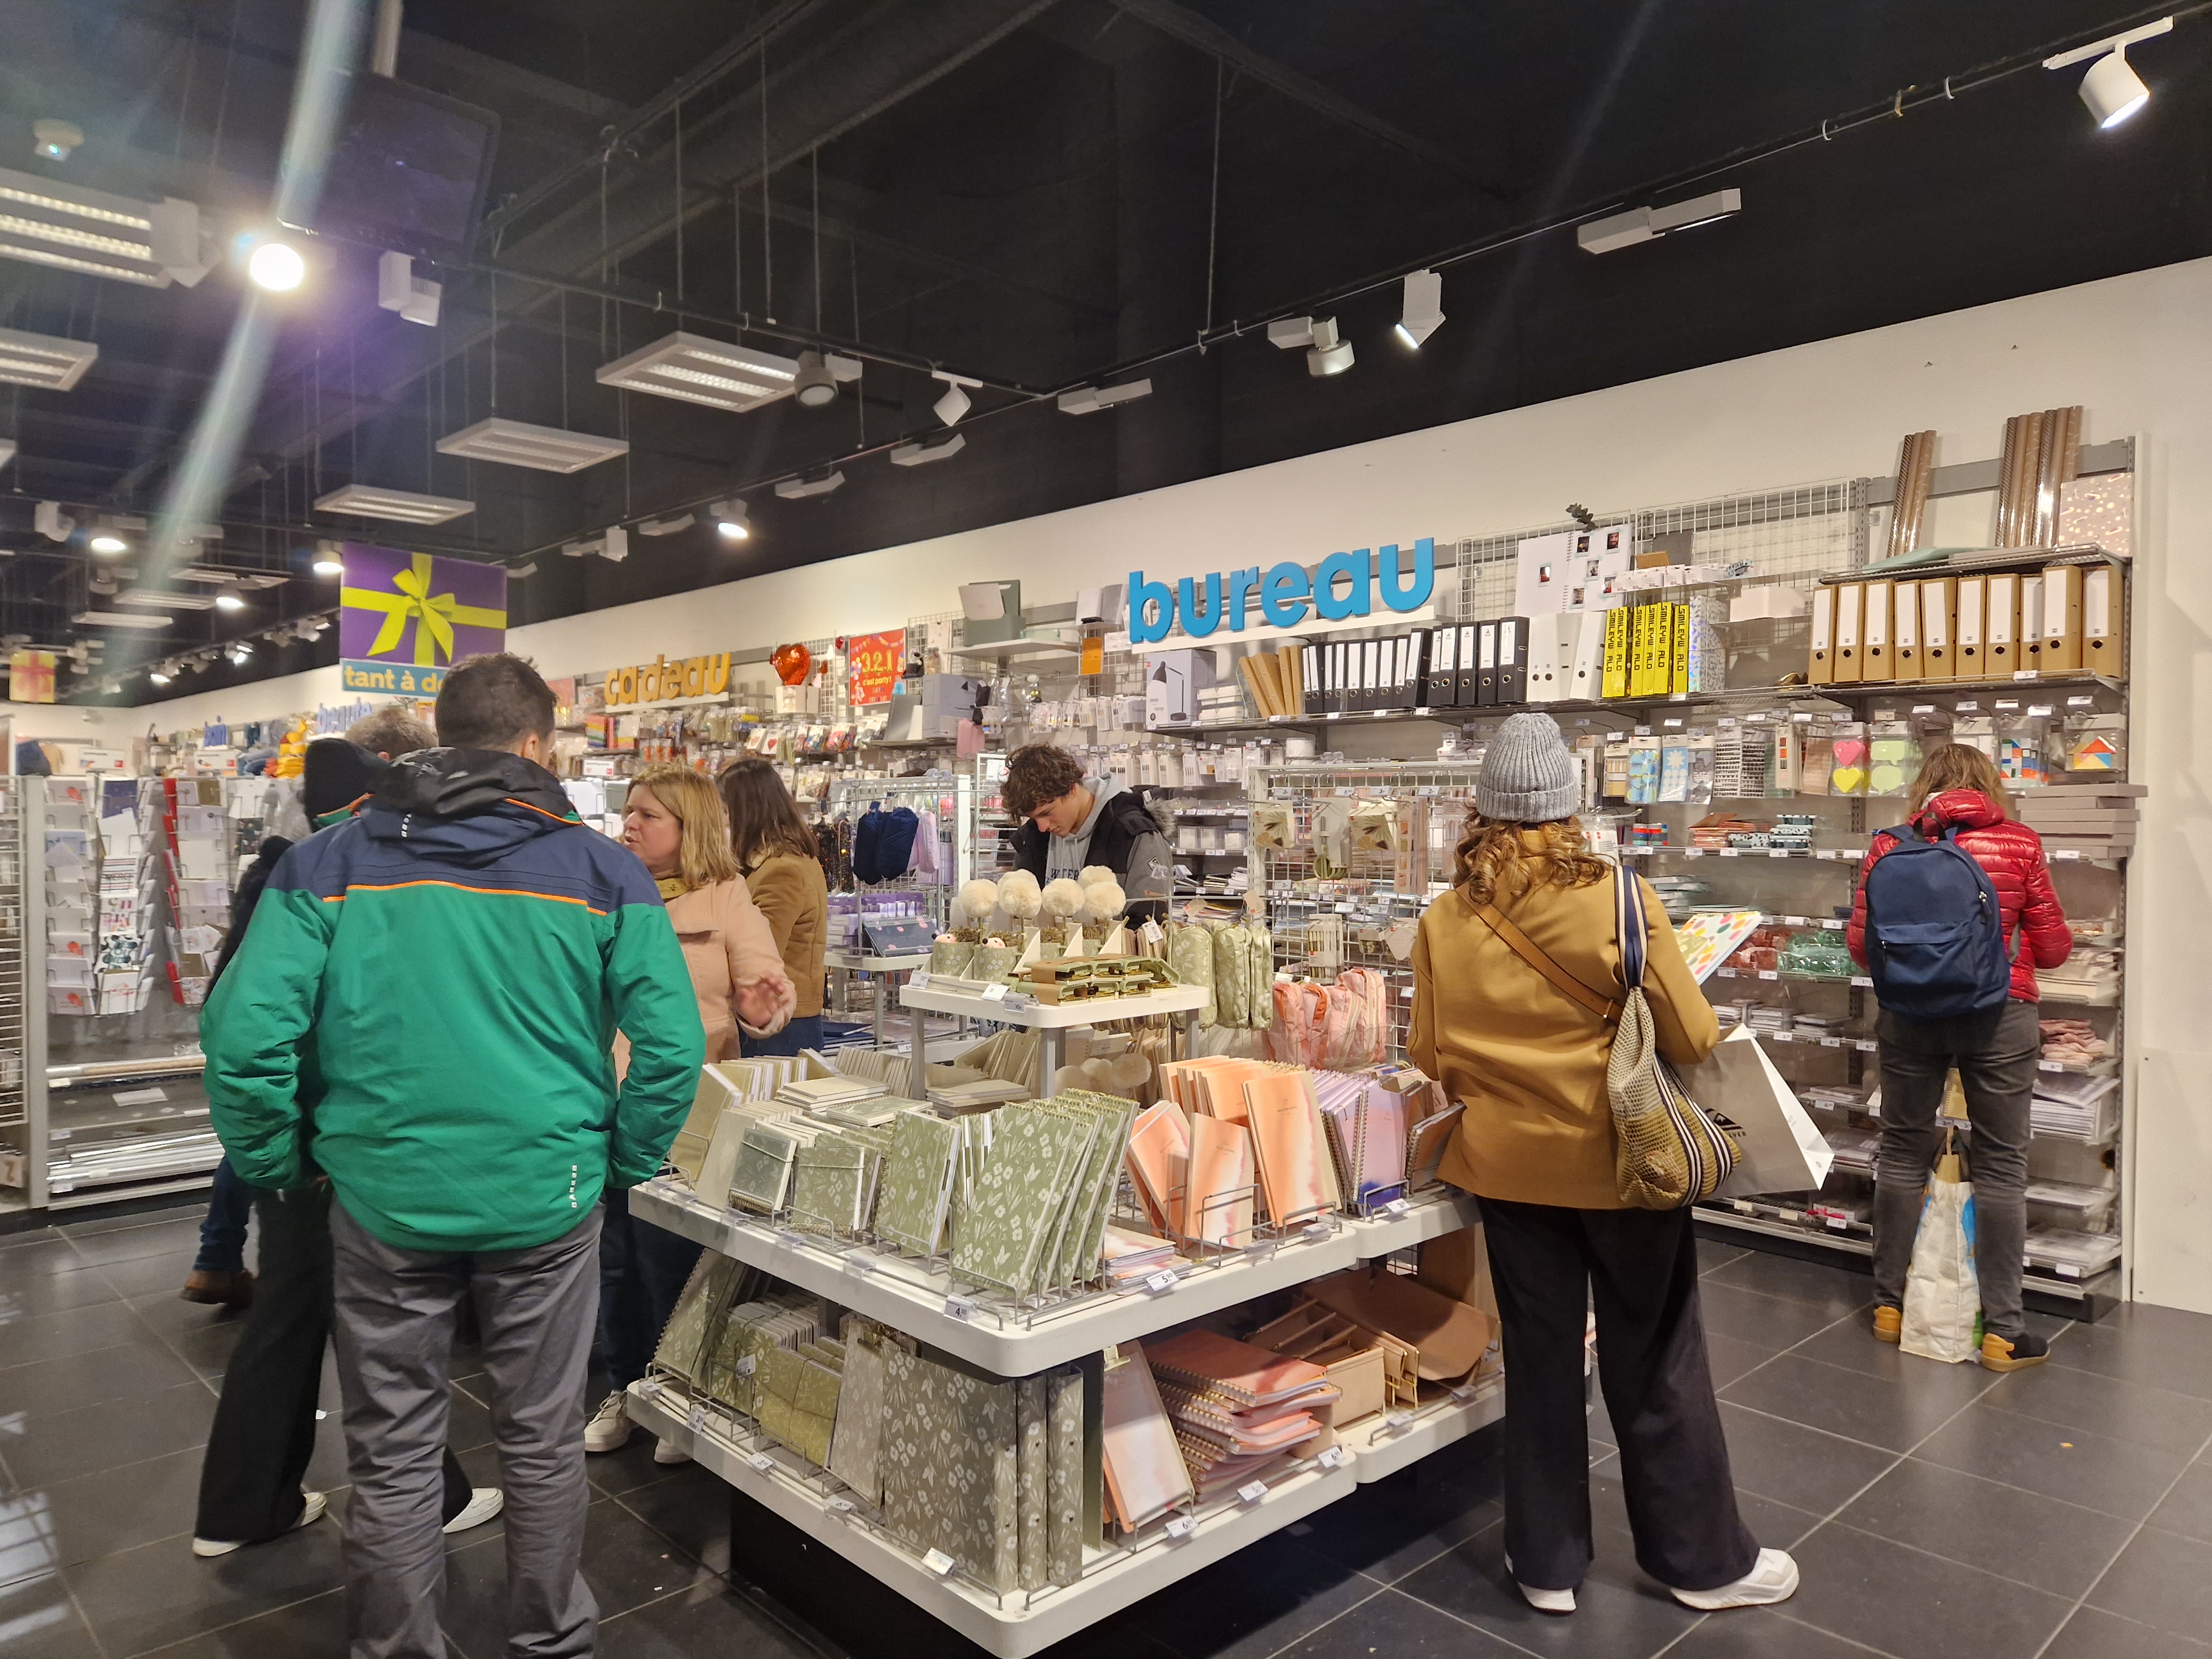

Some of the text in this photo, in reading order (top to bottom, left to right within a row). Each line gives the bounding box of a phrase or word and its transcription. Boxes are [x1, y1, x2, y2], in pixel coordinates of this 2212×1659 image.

[1129, 537, 1434, 643] bureau
[344, 665, 395, 690] tant
[400, 670, 416, 691] à
[604, 653, 732, 705] cadeau
[1161, 1272, 1173, 1283] 5.50
[956, 1307, 967, 1317] 4.50
